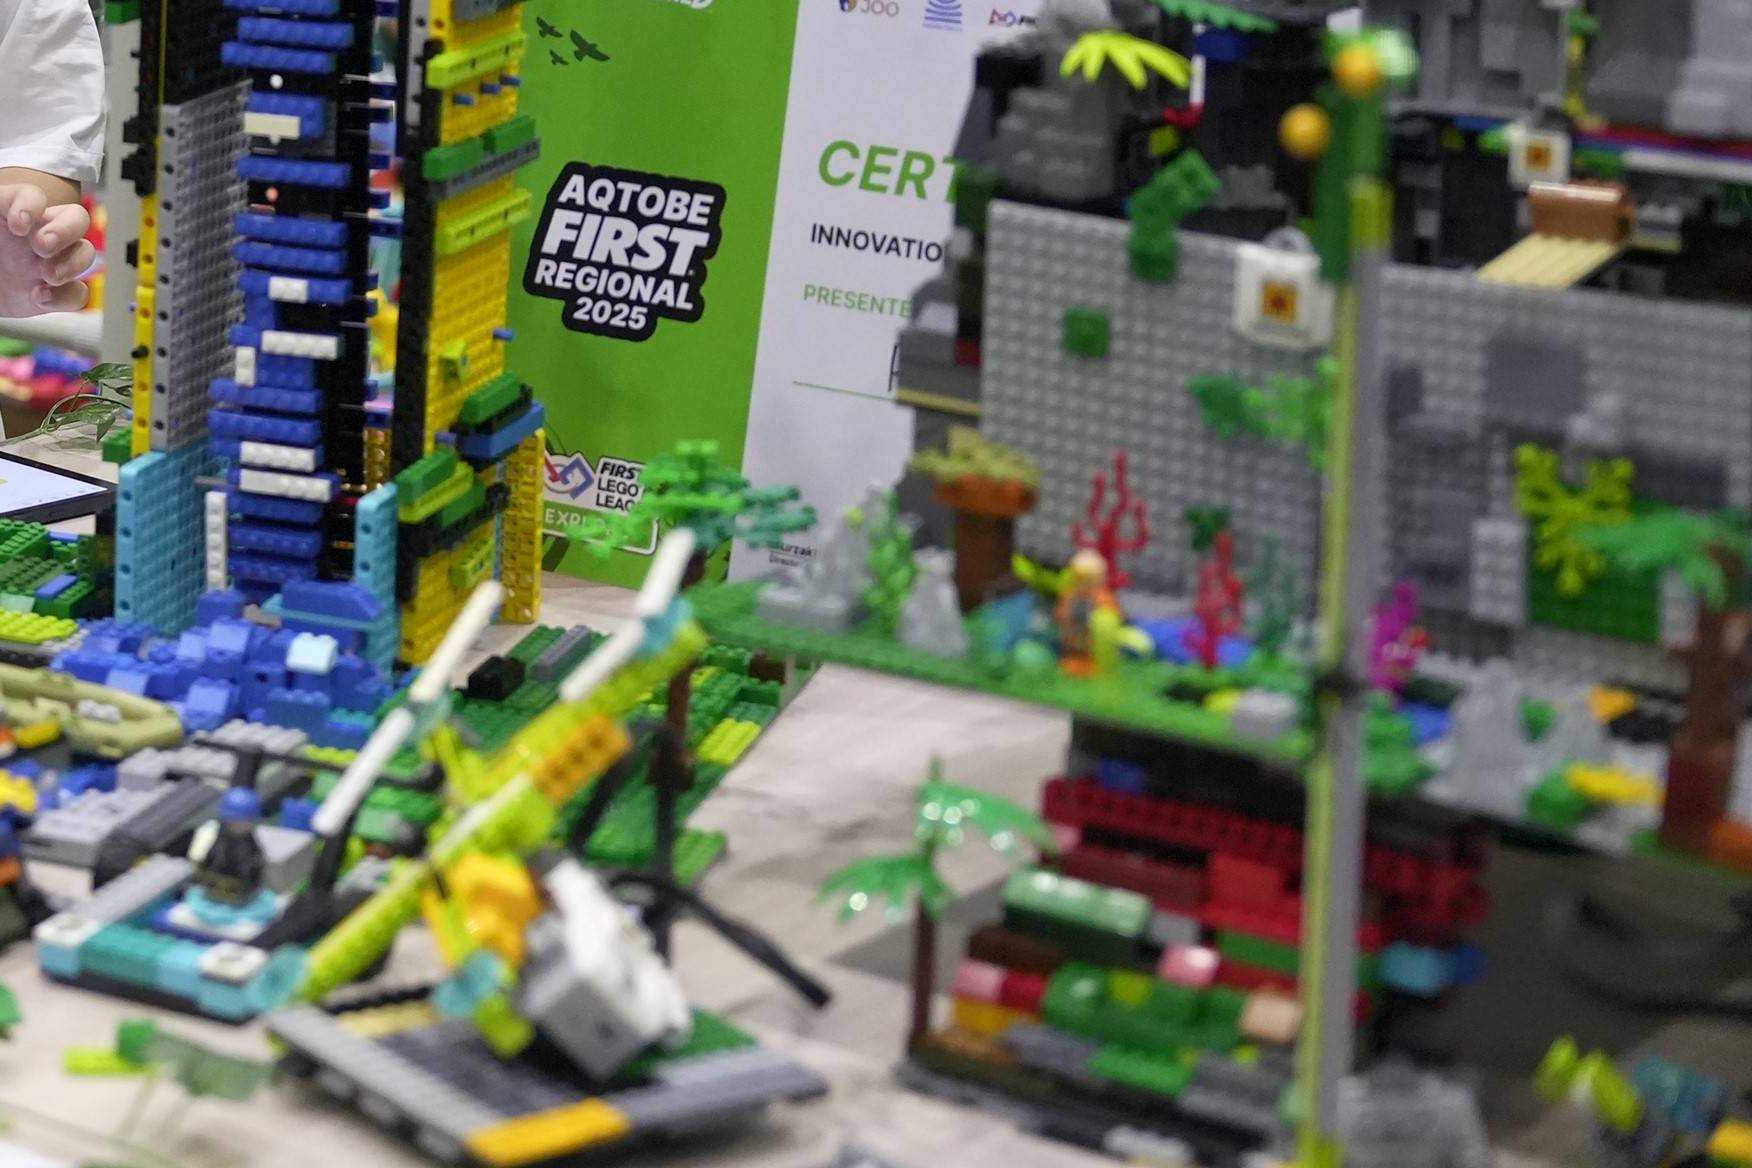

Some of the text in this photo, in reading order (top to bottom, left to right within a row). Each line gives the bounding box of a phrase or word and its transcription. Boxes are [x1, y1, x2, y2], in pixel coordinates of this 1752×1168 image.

[557, 174, 715, 226] AQTOBE
[541, 208, 710, 277] FIRST
[534, 258, 694, 310] REGIONAL
[573, 296, 648, 330] 2025
[598, 479, 639, 497] LEGO
